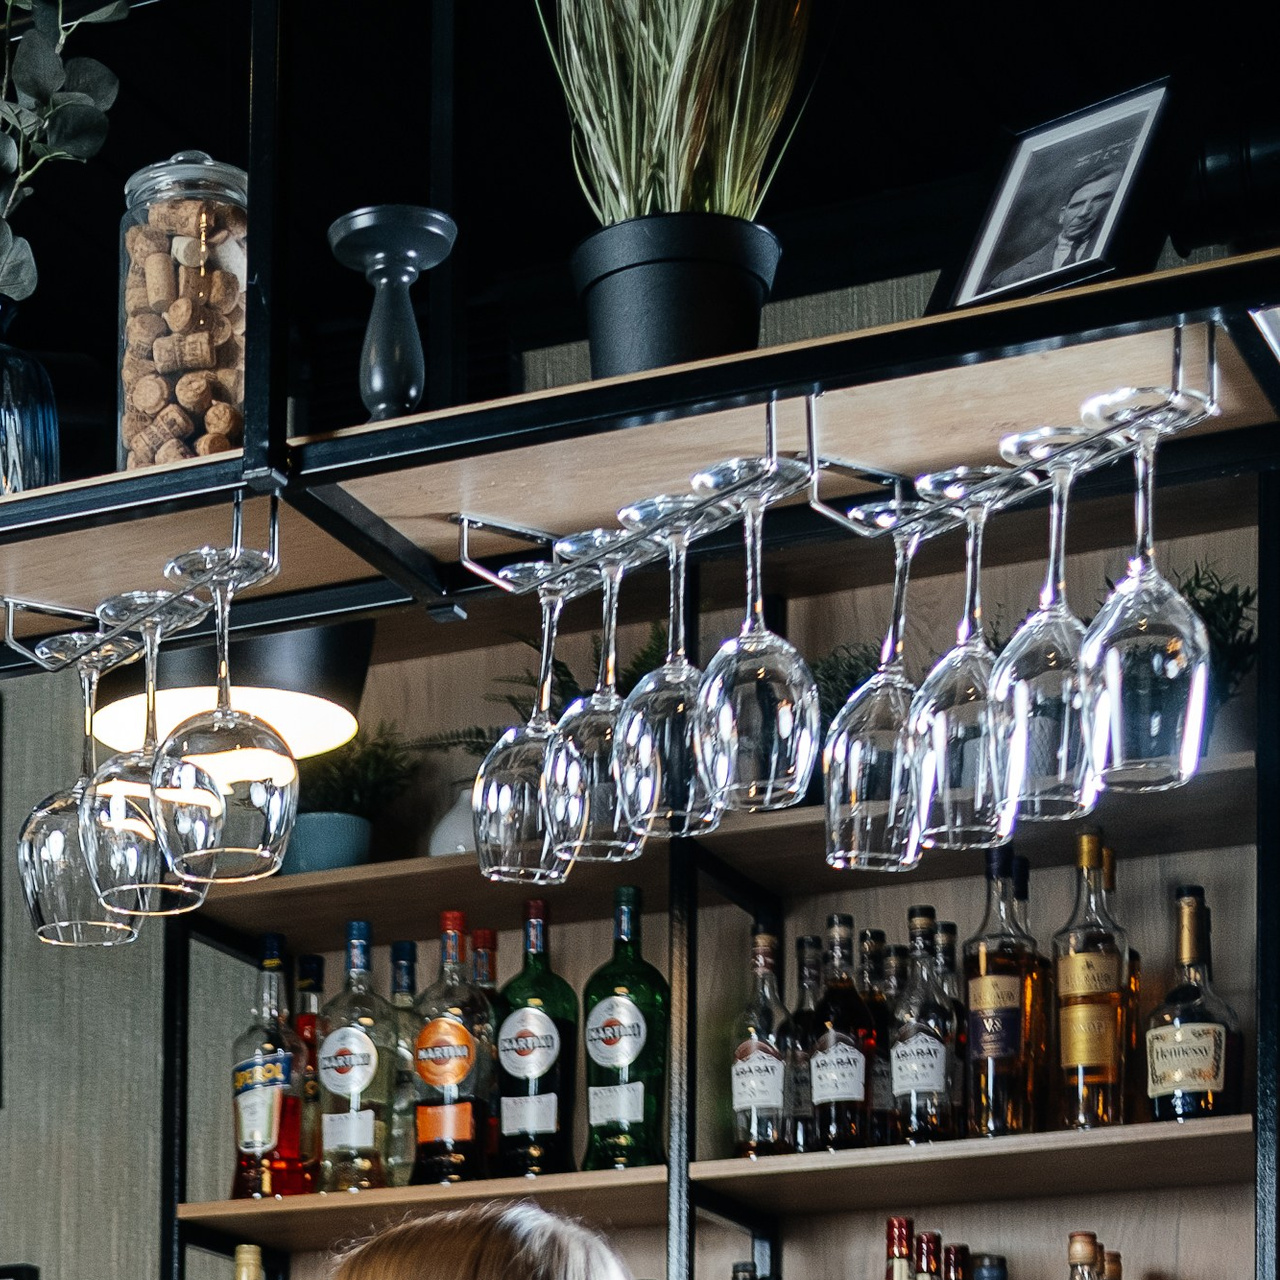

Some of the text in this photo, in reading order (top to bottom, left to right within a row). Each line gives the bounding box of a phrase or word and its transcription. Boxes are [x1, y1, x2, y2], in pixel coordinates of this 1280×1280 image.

[587, 1021, 641, 1041] MARTINI
[500, 1034, 555, 1052] MARTINI
[417, 1044, 469, 1061] MARTINI
